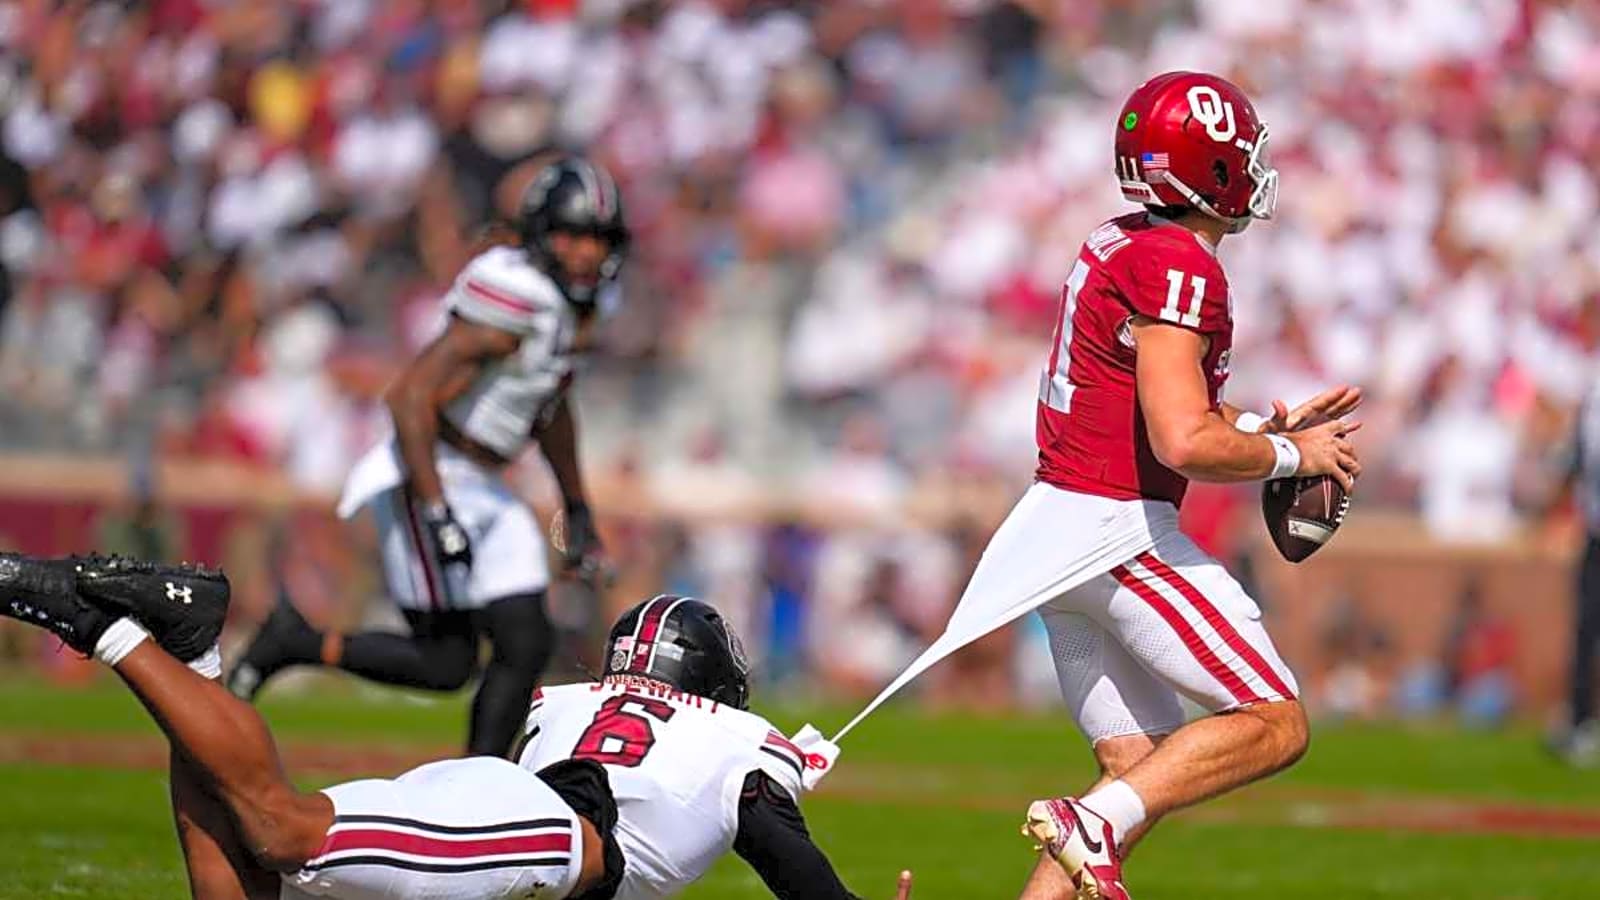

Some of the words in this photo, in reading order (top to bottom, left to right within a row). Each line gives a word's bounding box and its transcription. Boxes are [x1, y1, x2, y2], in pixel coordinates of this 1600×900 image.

[1186, 86, 1237, 142] OU
[1159, 268, 1207, 328] 11
[570, 693, 676, 767] 6
